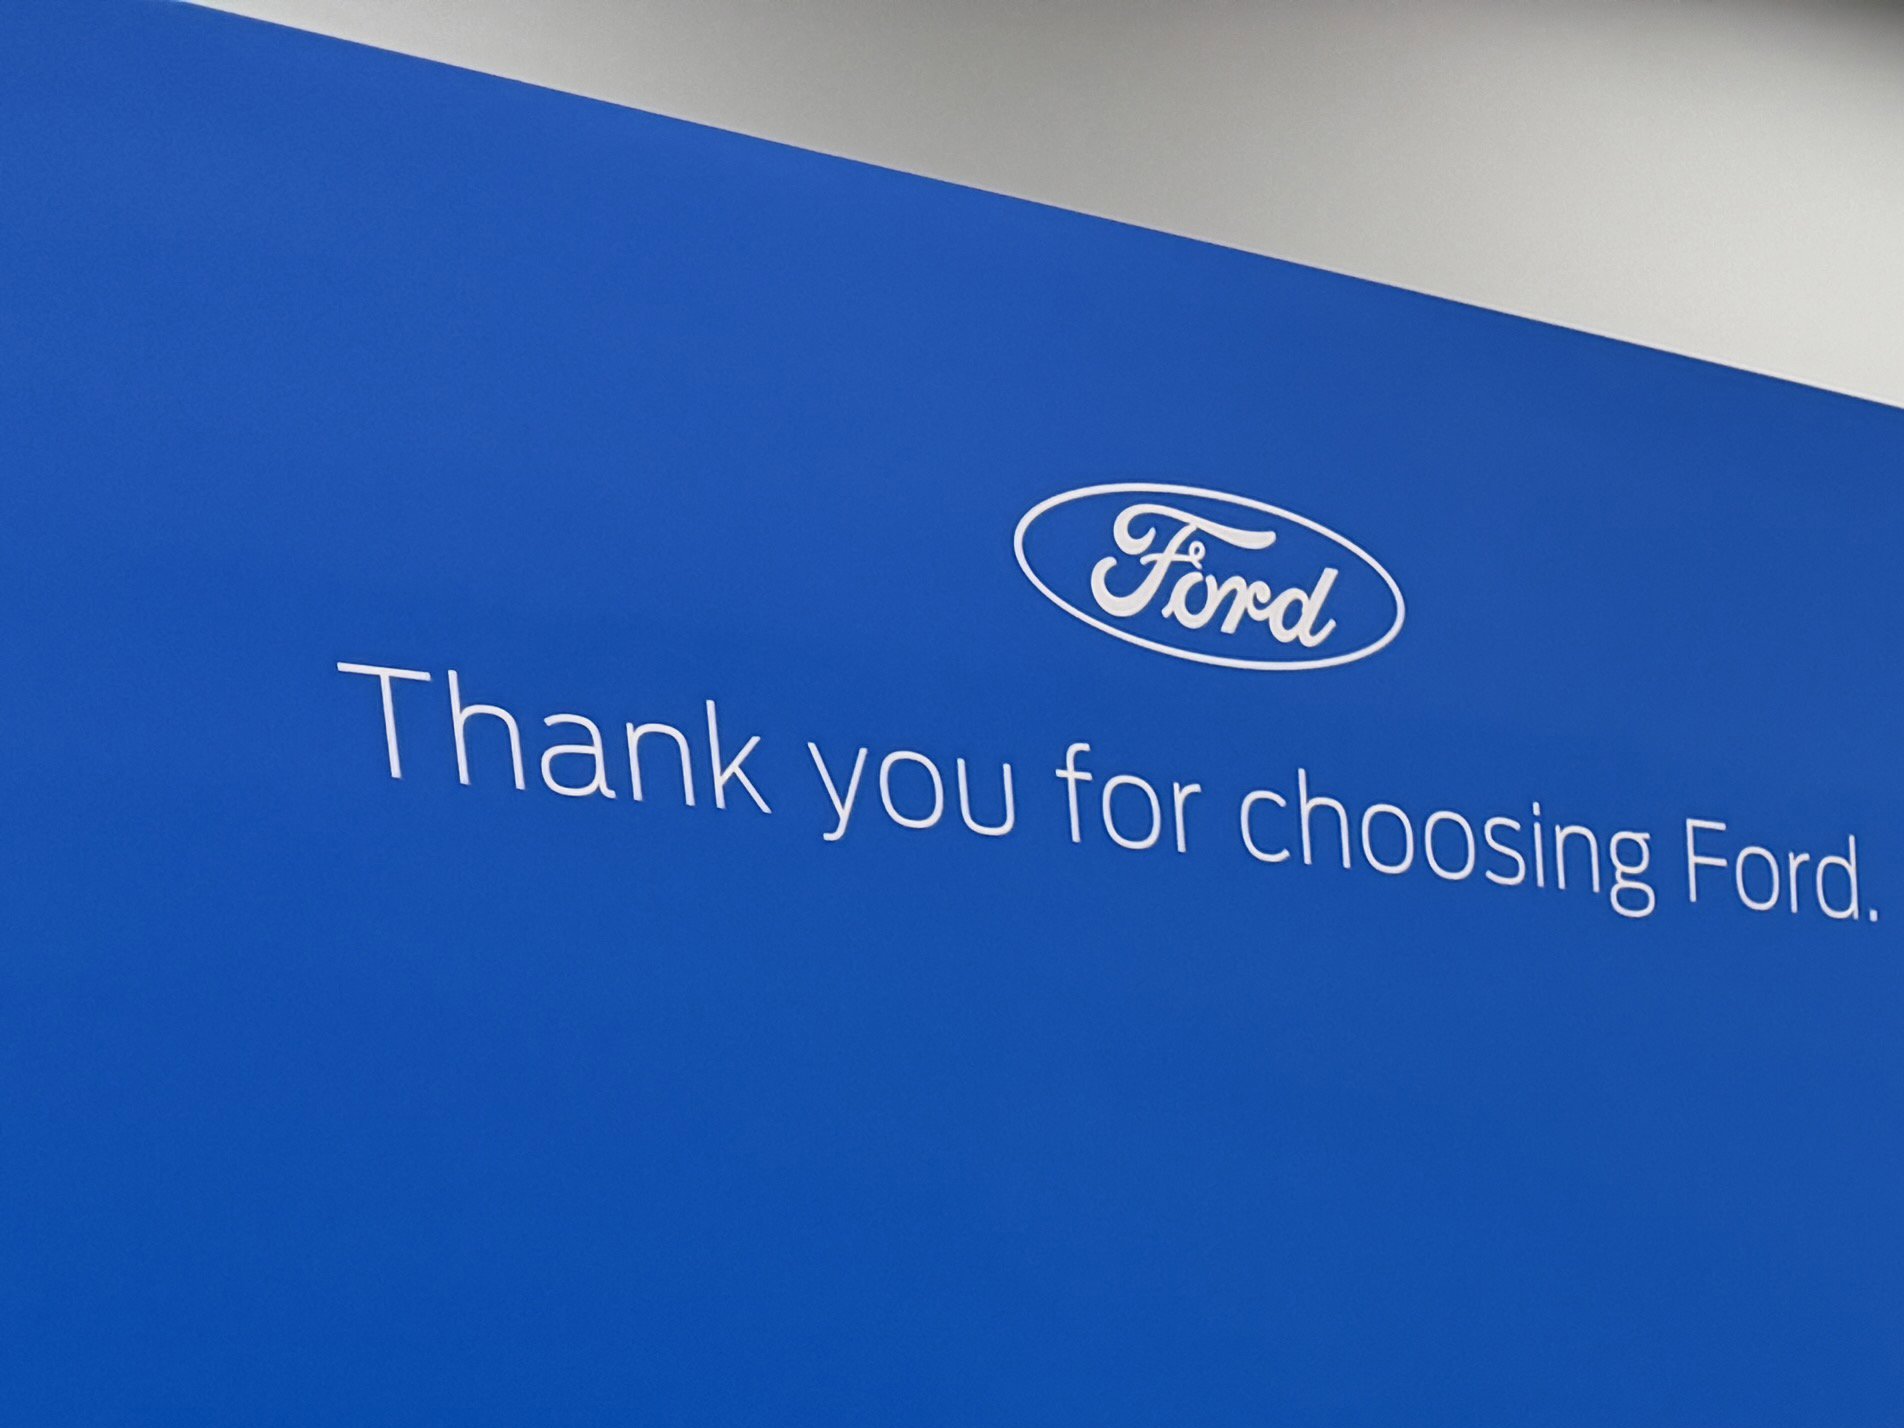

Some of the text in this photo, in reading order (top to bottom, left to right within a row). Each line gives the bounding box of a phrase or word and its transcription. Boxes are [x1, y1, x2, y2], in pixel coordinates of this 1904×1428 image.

[1090, 503, 1339, 648] Ford
[336, 661, 1883, 924] Thank you for choosing Ford.
